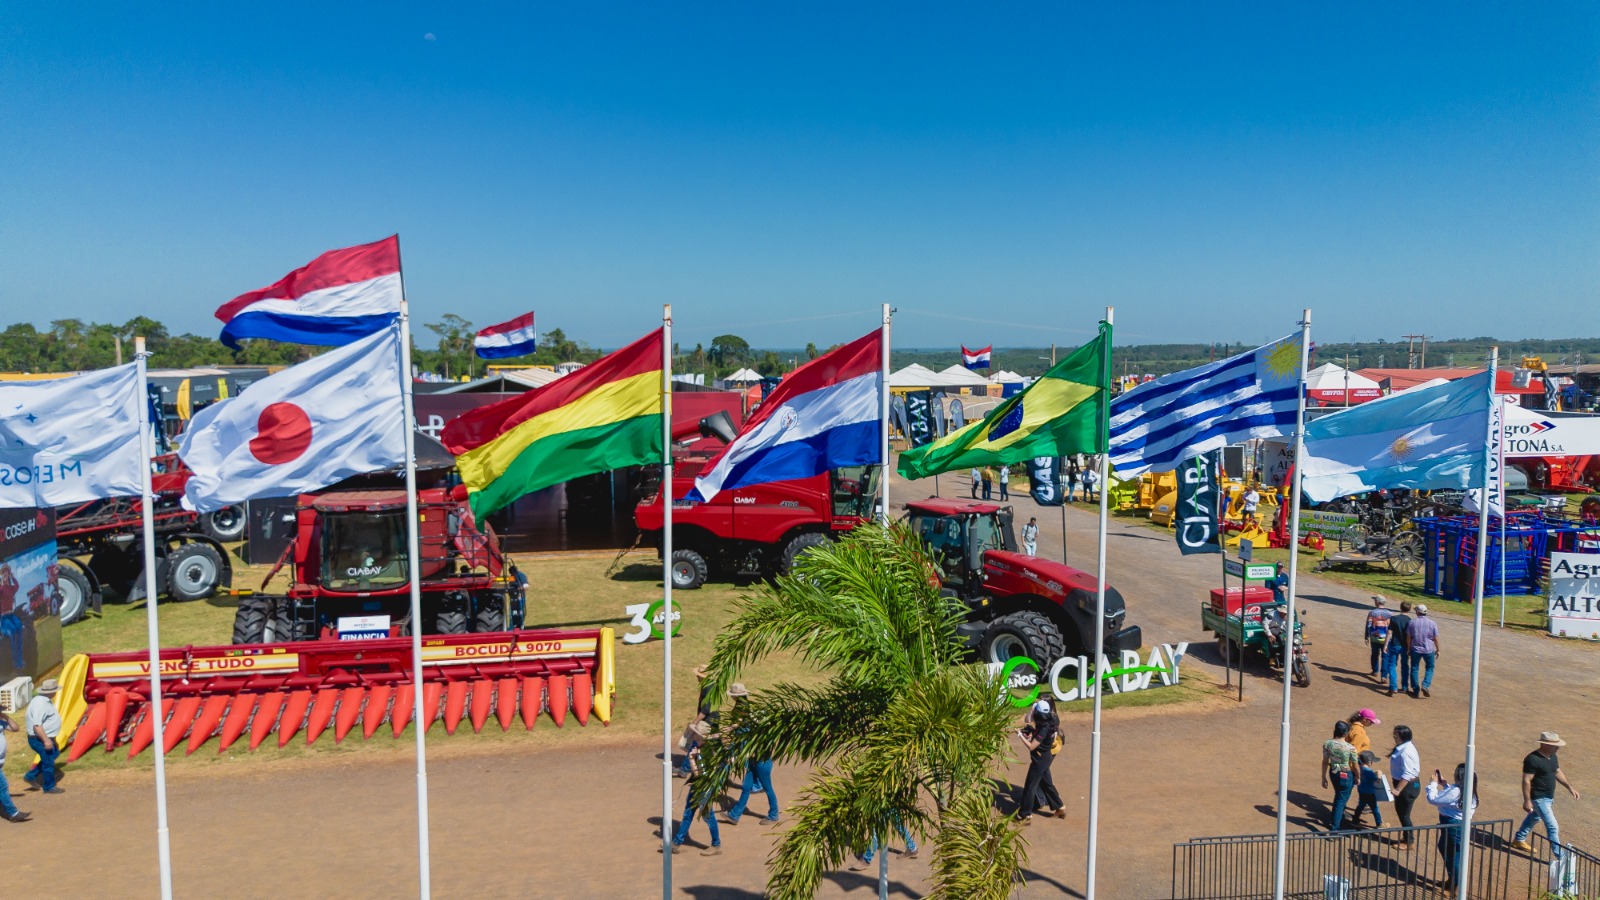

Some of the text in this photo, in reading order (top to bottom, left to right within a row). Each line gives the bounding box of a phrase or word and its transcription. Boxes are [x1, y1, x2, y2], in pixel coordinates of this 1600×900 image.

[1504, 425, 1530, 438] gro
[1504, 439, 1549, 452] TONA
[347, 566, 382, 576] CIABAY
[455, 642, 562, 657] BOCUDA 9070
[206, 658, 255, 670] TUDO
[1051, 642, 1189, 702] CIABAY
[1008, 673, 1037, 688] AÑOS
